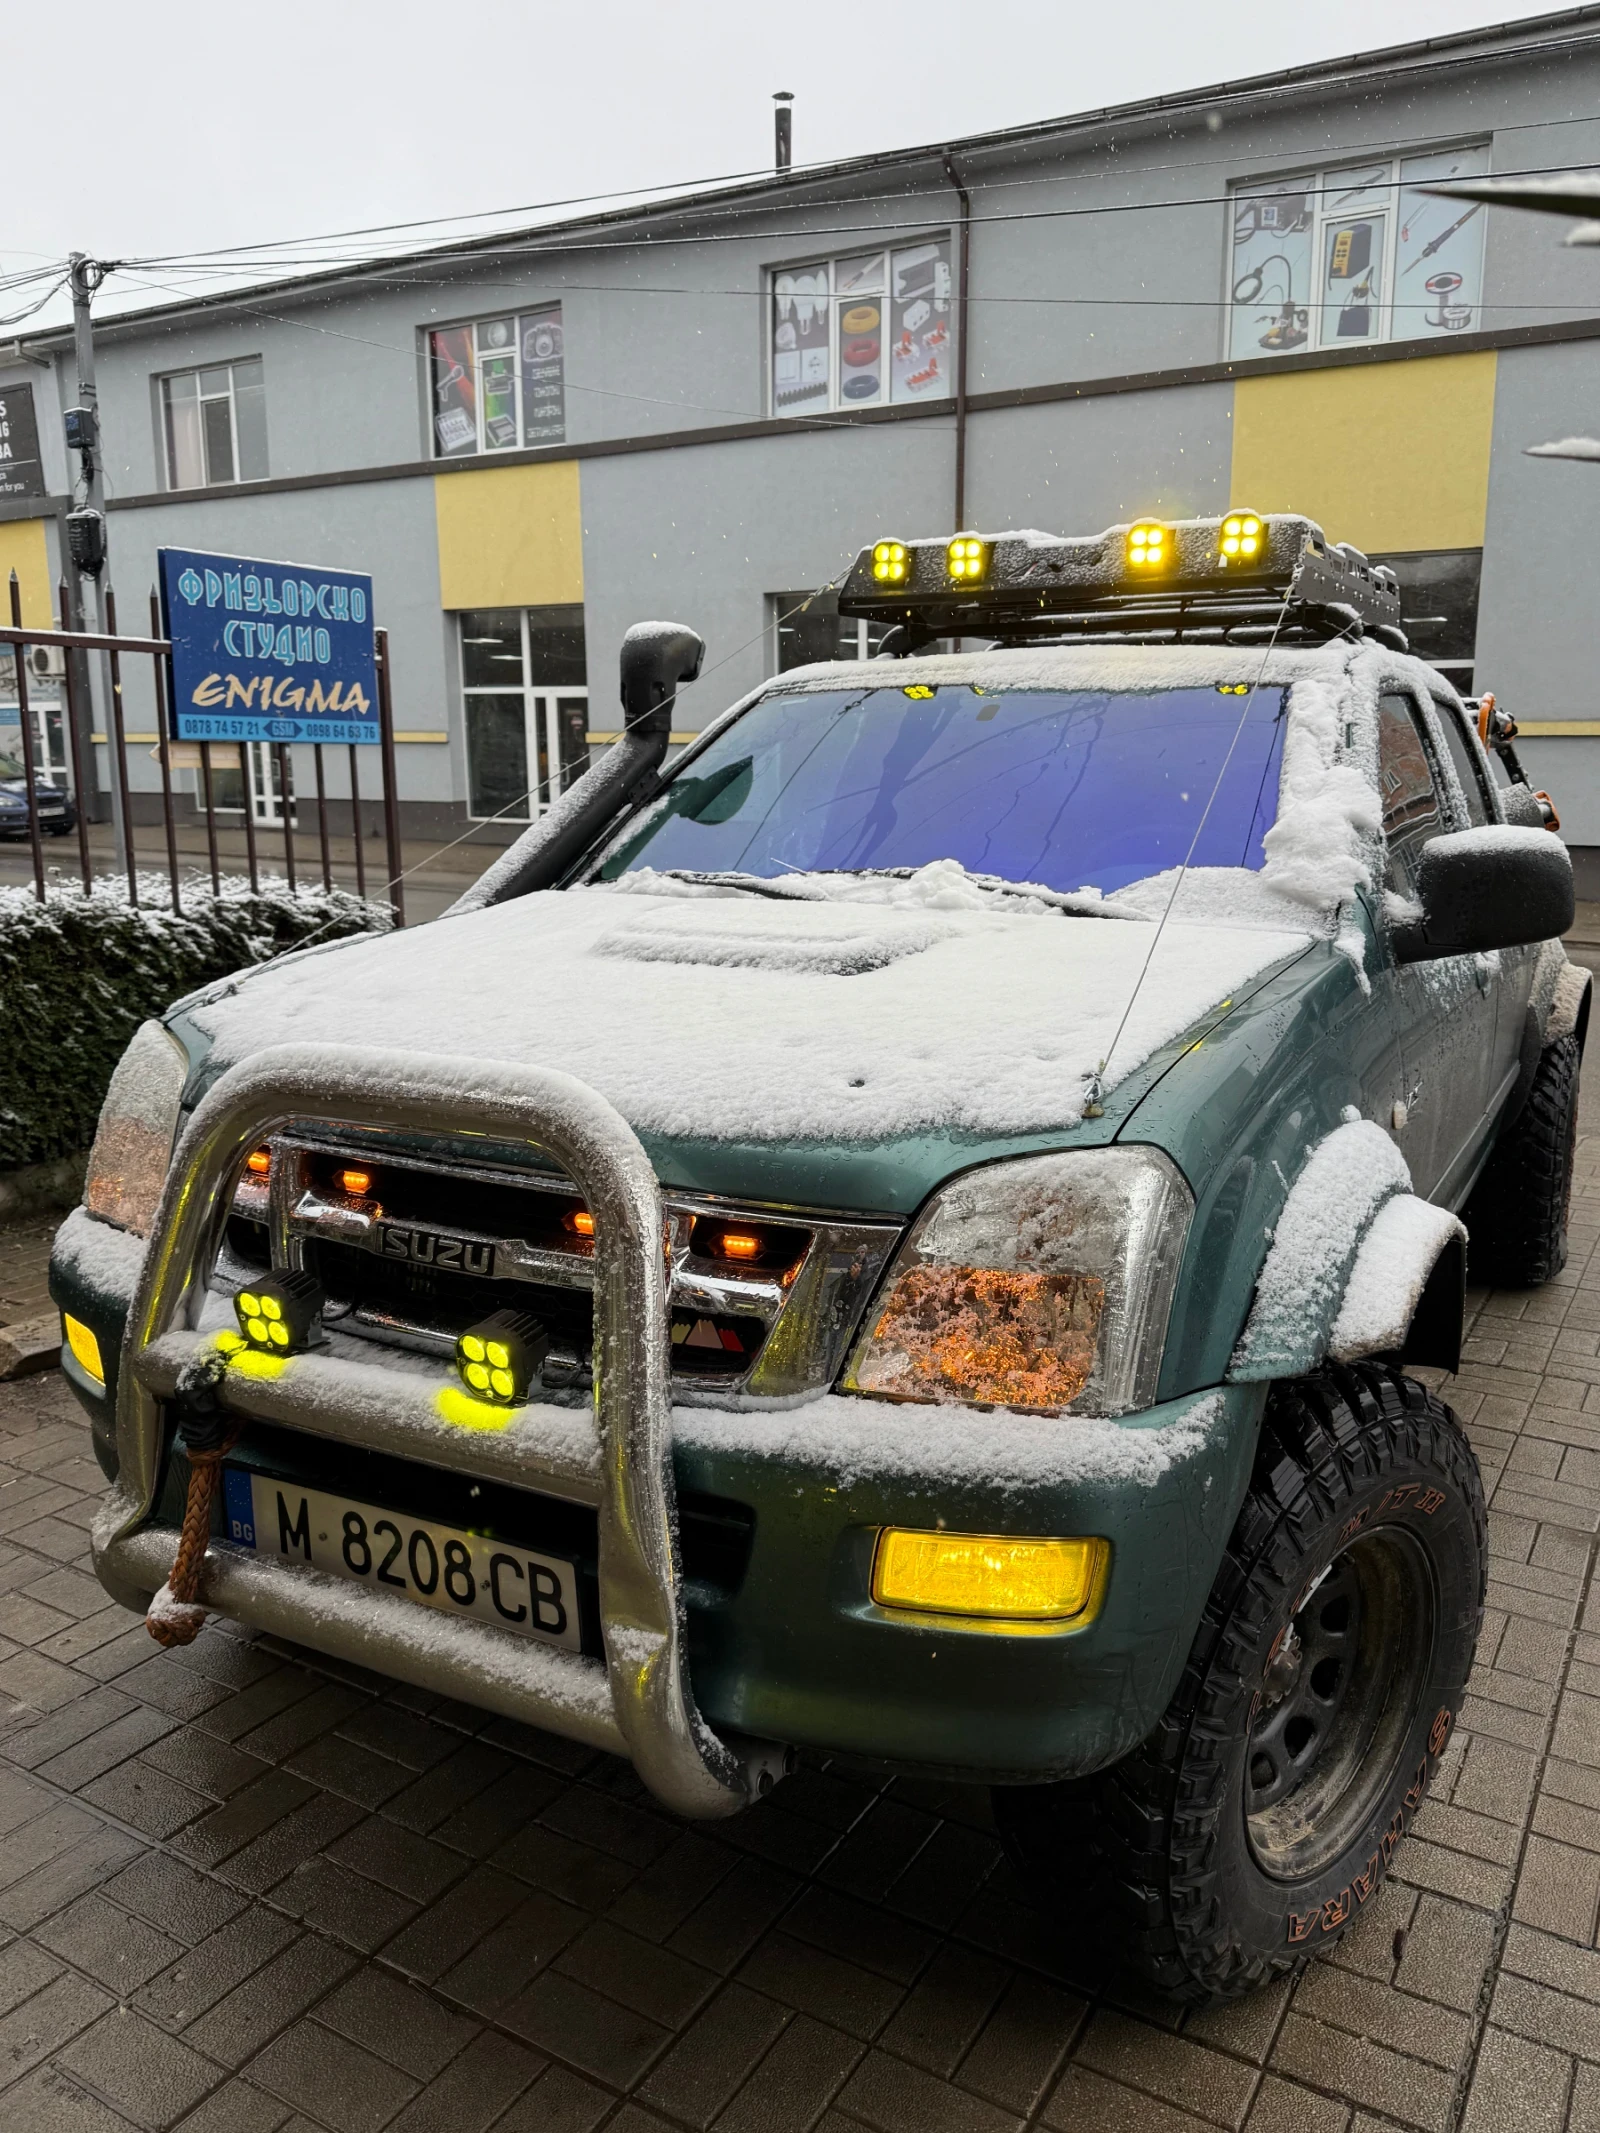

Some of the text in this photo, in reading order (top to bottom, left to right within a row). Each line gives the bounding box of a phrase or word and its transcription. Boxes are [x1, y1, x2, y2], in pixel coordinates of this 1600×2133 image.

[178, 568, 367, 624] ФРИЗЬОРСКО
[223, 620, 331, 666] СТУДИО
[192, 673, 371, 715] ENIGMA
[184, 719, 376, 740] 0878 74 57 21 GSM 0898 64 63 76
[378, 1226, 491, 1274] ISUZU
[231, 1520, 253, 1542] BG
[276, 1490, 568, 1635] M 8208 CB
[1287, 1705, 1451, 1943] SAHARA
